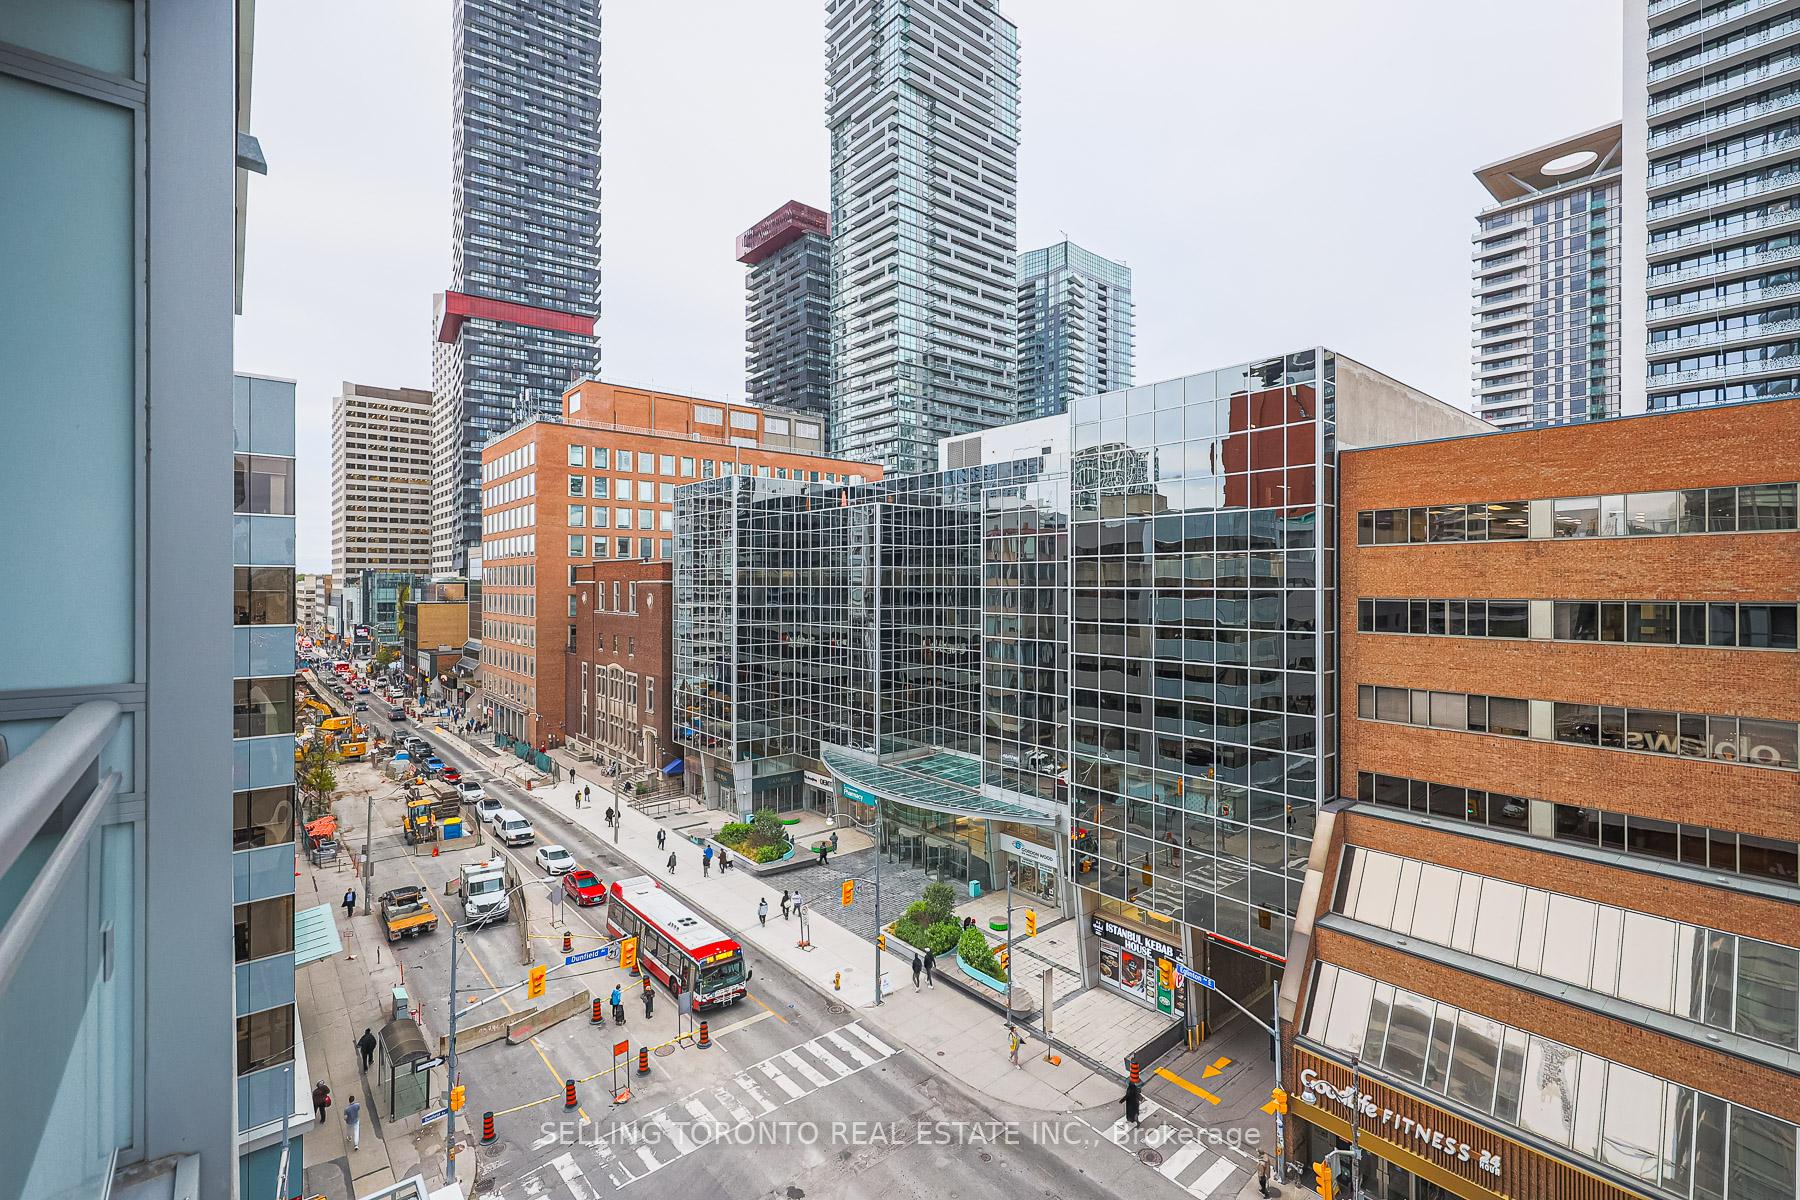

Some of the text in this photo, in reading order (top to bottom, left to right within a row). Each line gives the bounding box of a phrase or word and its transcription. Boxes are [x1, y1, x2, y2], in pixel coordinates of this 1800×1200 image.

[843, 788, 863, 802] Pharmacy
[1105, 922, 1143, 946] ISTANBUL
[1145, 937, 1174, 957] KEBAB
[1125, 939, 1152, 958] HOUSE
[571, 950, 599, 963] Dunfield
[1382, 1109, 1470, 1162] FITNESS
[1479, 1149, 1501, 1167] 24
[1479, 1160, 1501, 1177] HOUR
